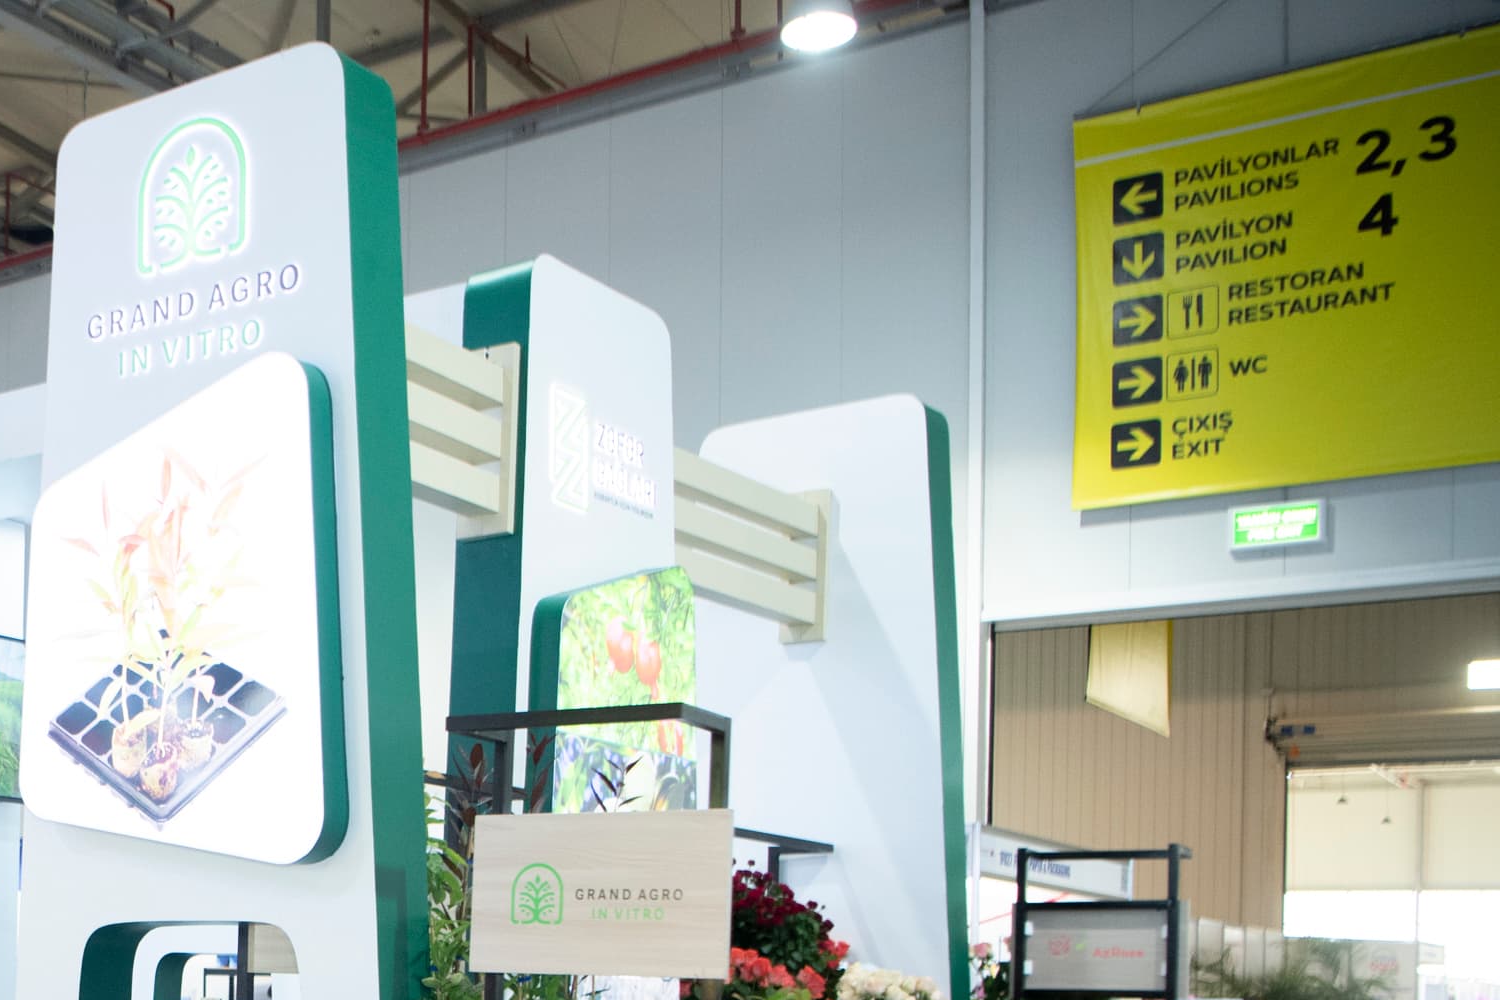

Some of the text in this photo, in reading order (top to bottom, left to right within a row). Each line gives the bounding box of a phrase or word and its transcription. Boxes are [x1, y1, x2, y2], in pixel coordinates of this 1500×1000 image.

[1174, 138, 1340, 187] PAVİLYONLAR
[1174, 171, 1300, 211] PAVILIONS
[1175, 211, 1294, 249] PAVİLYON
[1357, 192, 1399, 236] 4
[1175, 238, 1288, 274] PAVILION
[1227, 261, 1365, 301] RESTORAN
[87, 264, 300, 340] GRAND AGRO
[1227, 281, 1396, 326] RESTAURANT
[118, 319, 261, 376] IN VITRO
[1229, 354, 1269, 377] WC
[1172, 411, 1233, 439] ÇIXIŞ
[1172, 437, 1225, 461] EXIT
[575, 888, 684, 901] GRAND AGRO
[591, 908, 665, 921] IN VITRO
